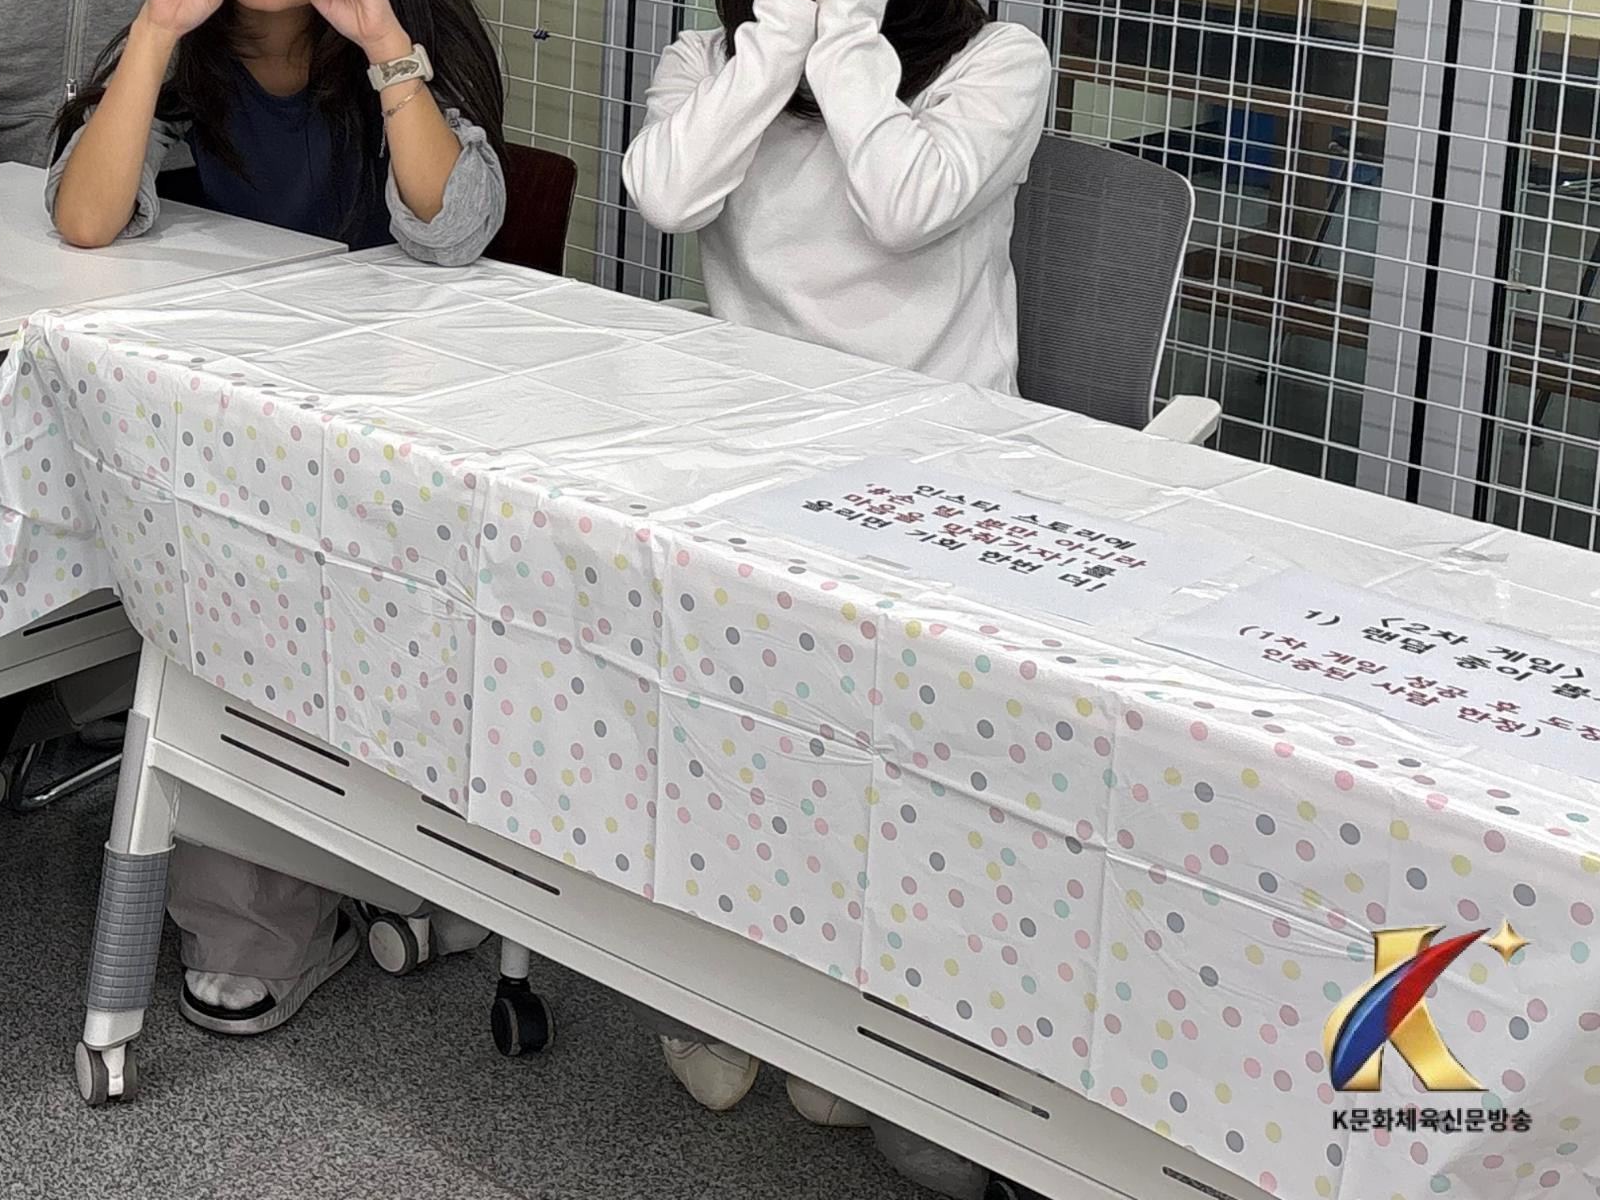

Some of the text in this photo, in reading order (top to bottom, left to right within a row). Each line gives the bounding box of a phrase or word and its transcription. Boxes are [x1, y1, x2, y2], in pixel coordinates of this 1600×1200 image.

[802, 499, 1107, 592] 올리면 기회 한번 더!
[843, 493, 926, 524] 마음을
[913, 484, 1137, 551] 인스타 스토리에
[932, 504, 965, 519] 발
[974, 517, 1039, 540] 뿐만
[1055, 538, 1148, 569] 아니라
[1238, 625, 1308, 650] (1차
[1321, 650, 1388, 675] 게임
[1404, 675, 1469, 699] 성공
[1485, 700, 1521, 715] 후
[1304, 609, 1600, 701] 1) 랜덤 종이 뽑
[1380, 617, 1585, 680] <2차 게임>
[1261, 648, 1541, 738] 인증된 사람 한정)
